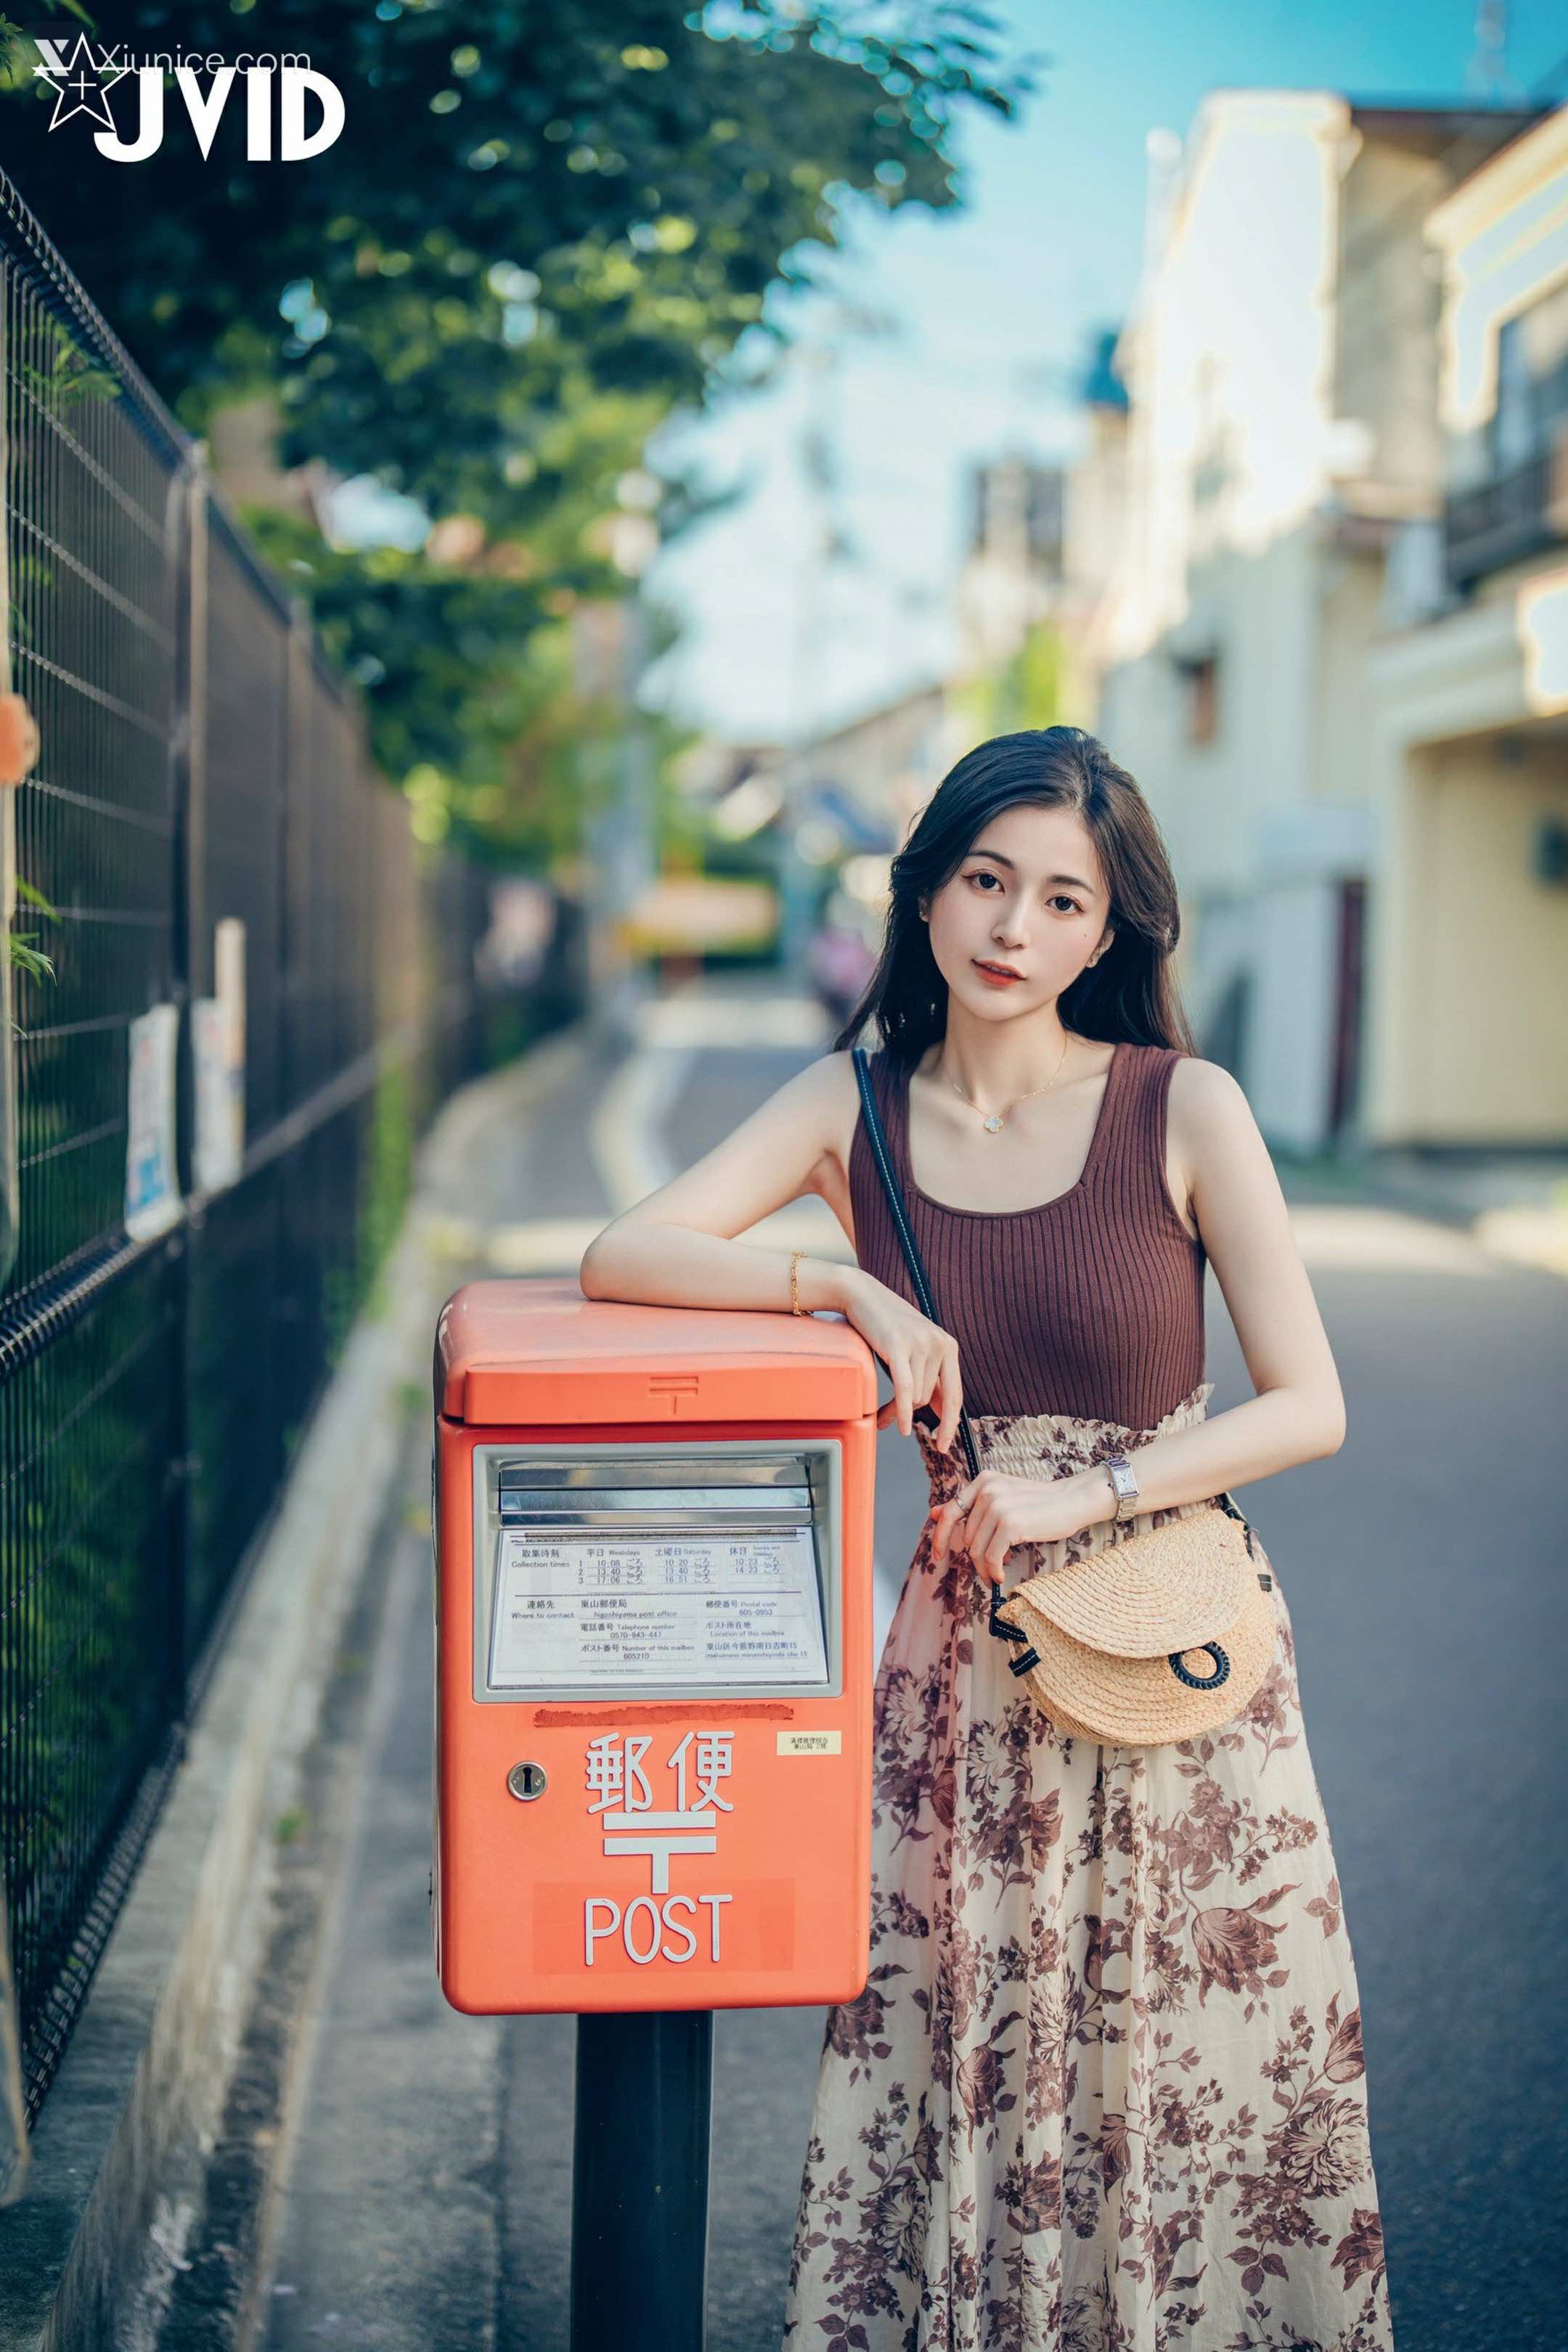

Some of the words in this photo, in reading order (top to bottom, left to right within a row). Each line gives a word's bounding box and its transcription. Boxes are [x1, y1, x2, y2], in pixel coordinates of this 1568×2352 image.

[655, 1547, 681, 1556] 土曜日
[730, 1546, 746, 1555] 休日
[527, 1599, 555, 1609] 連絡先
[581, 1598, 627, 1608] 東山郵便局
[581, 1643, 619, 1652] ポスト番号
[585, 1731, 735, 1813] 郵便
[584, 1894, 734, 1967] POST
